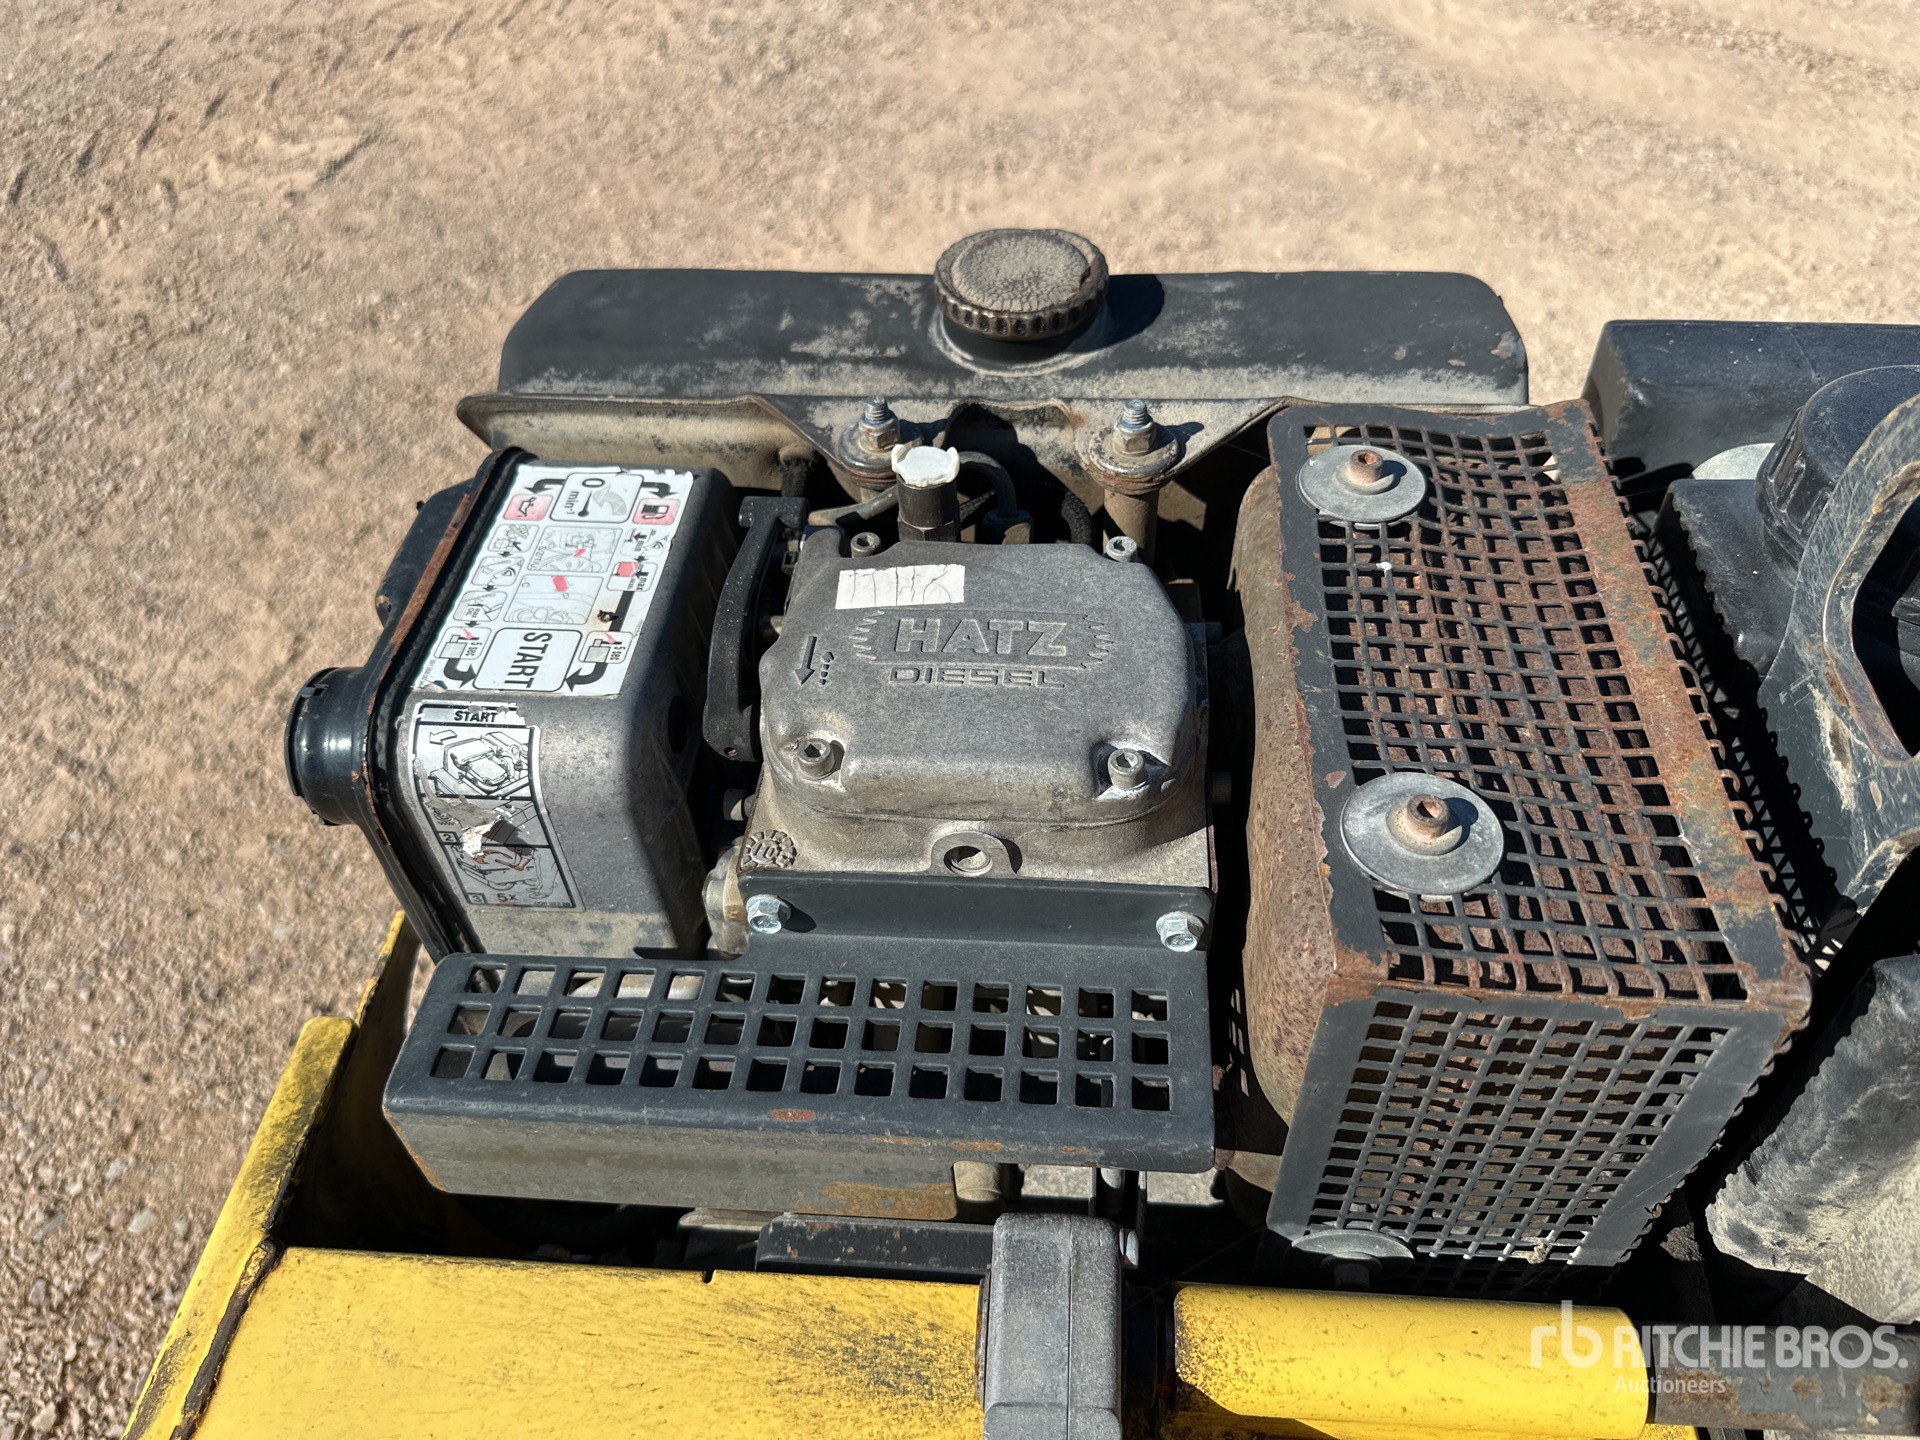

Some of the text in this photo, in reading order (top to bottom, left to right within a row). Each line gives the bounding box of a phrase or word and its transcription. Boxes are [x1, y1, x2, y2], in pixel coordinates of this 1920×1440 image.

[894, 618, 1067, 657] HATZ
[504, 632, 553, 689] START
[888, 667, 1065, 689] DIESEL
[454, 710, 498, 723] START
